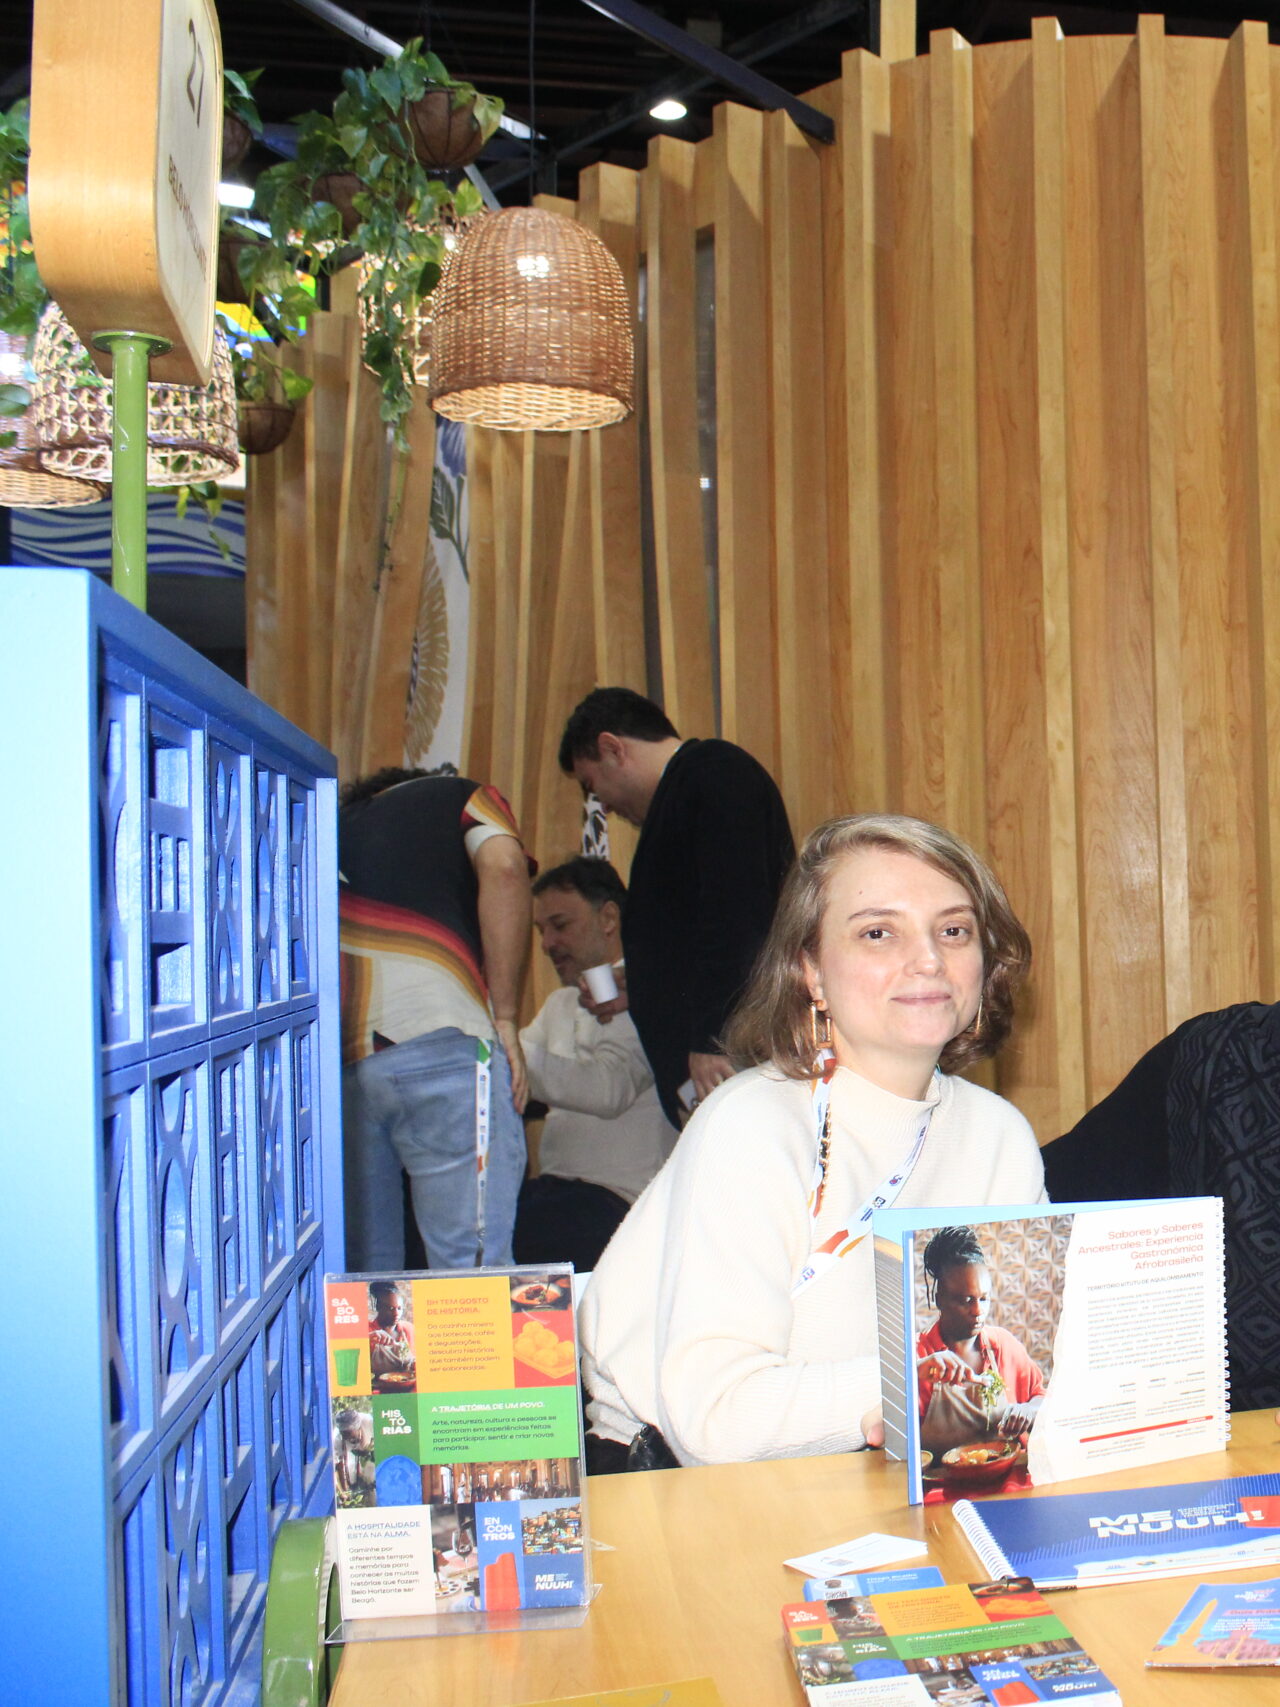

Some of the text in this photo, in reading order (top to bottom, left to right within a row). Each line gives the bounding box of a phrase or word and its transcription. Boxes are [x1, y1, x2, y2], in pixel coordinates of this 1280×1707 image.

[1108, 1222, 1203, 1240] Sabores y Saberes
[1078, 1232, 1204, 1255] Ancestrales: Experiencia
[1130, 1244, 1204, 1260] Gastronómica
[1135, 1255, 1204, 1271] Afrobrasileña
[332, 1298, 349, 1307] SA
[336, 1306, 354, 1315] BO
[334, 1314, 360, 1324] RES
[382, 1409, 401, 1418] HIS
[439, 1404, 492, 1413] TRAJETÓRIA
[390, 1415, 406, 1426] TÓ
[382, 1425, 412, 1436] RIAS
[484, 1516, 500, 1526] EN
[1089, 1510, 1173, 1528] ME
[1097, 1510, 1265, 1538] NUUH!
[354, 1521, 420, 1530] HOSPITALIDADE
[486, 1524, 512, 1533] CON
[482, 1532, 516, 1541] TROS
[535, 1574, 555, 1582] ME
[536, 1580, 575, 1590] NUUH!
